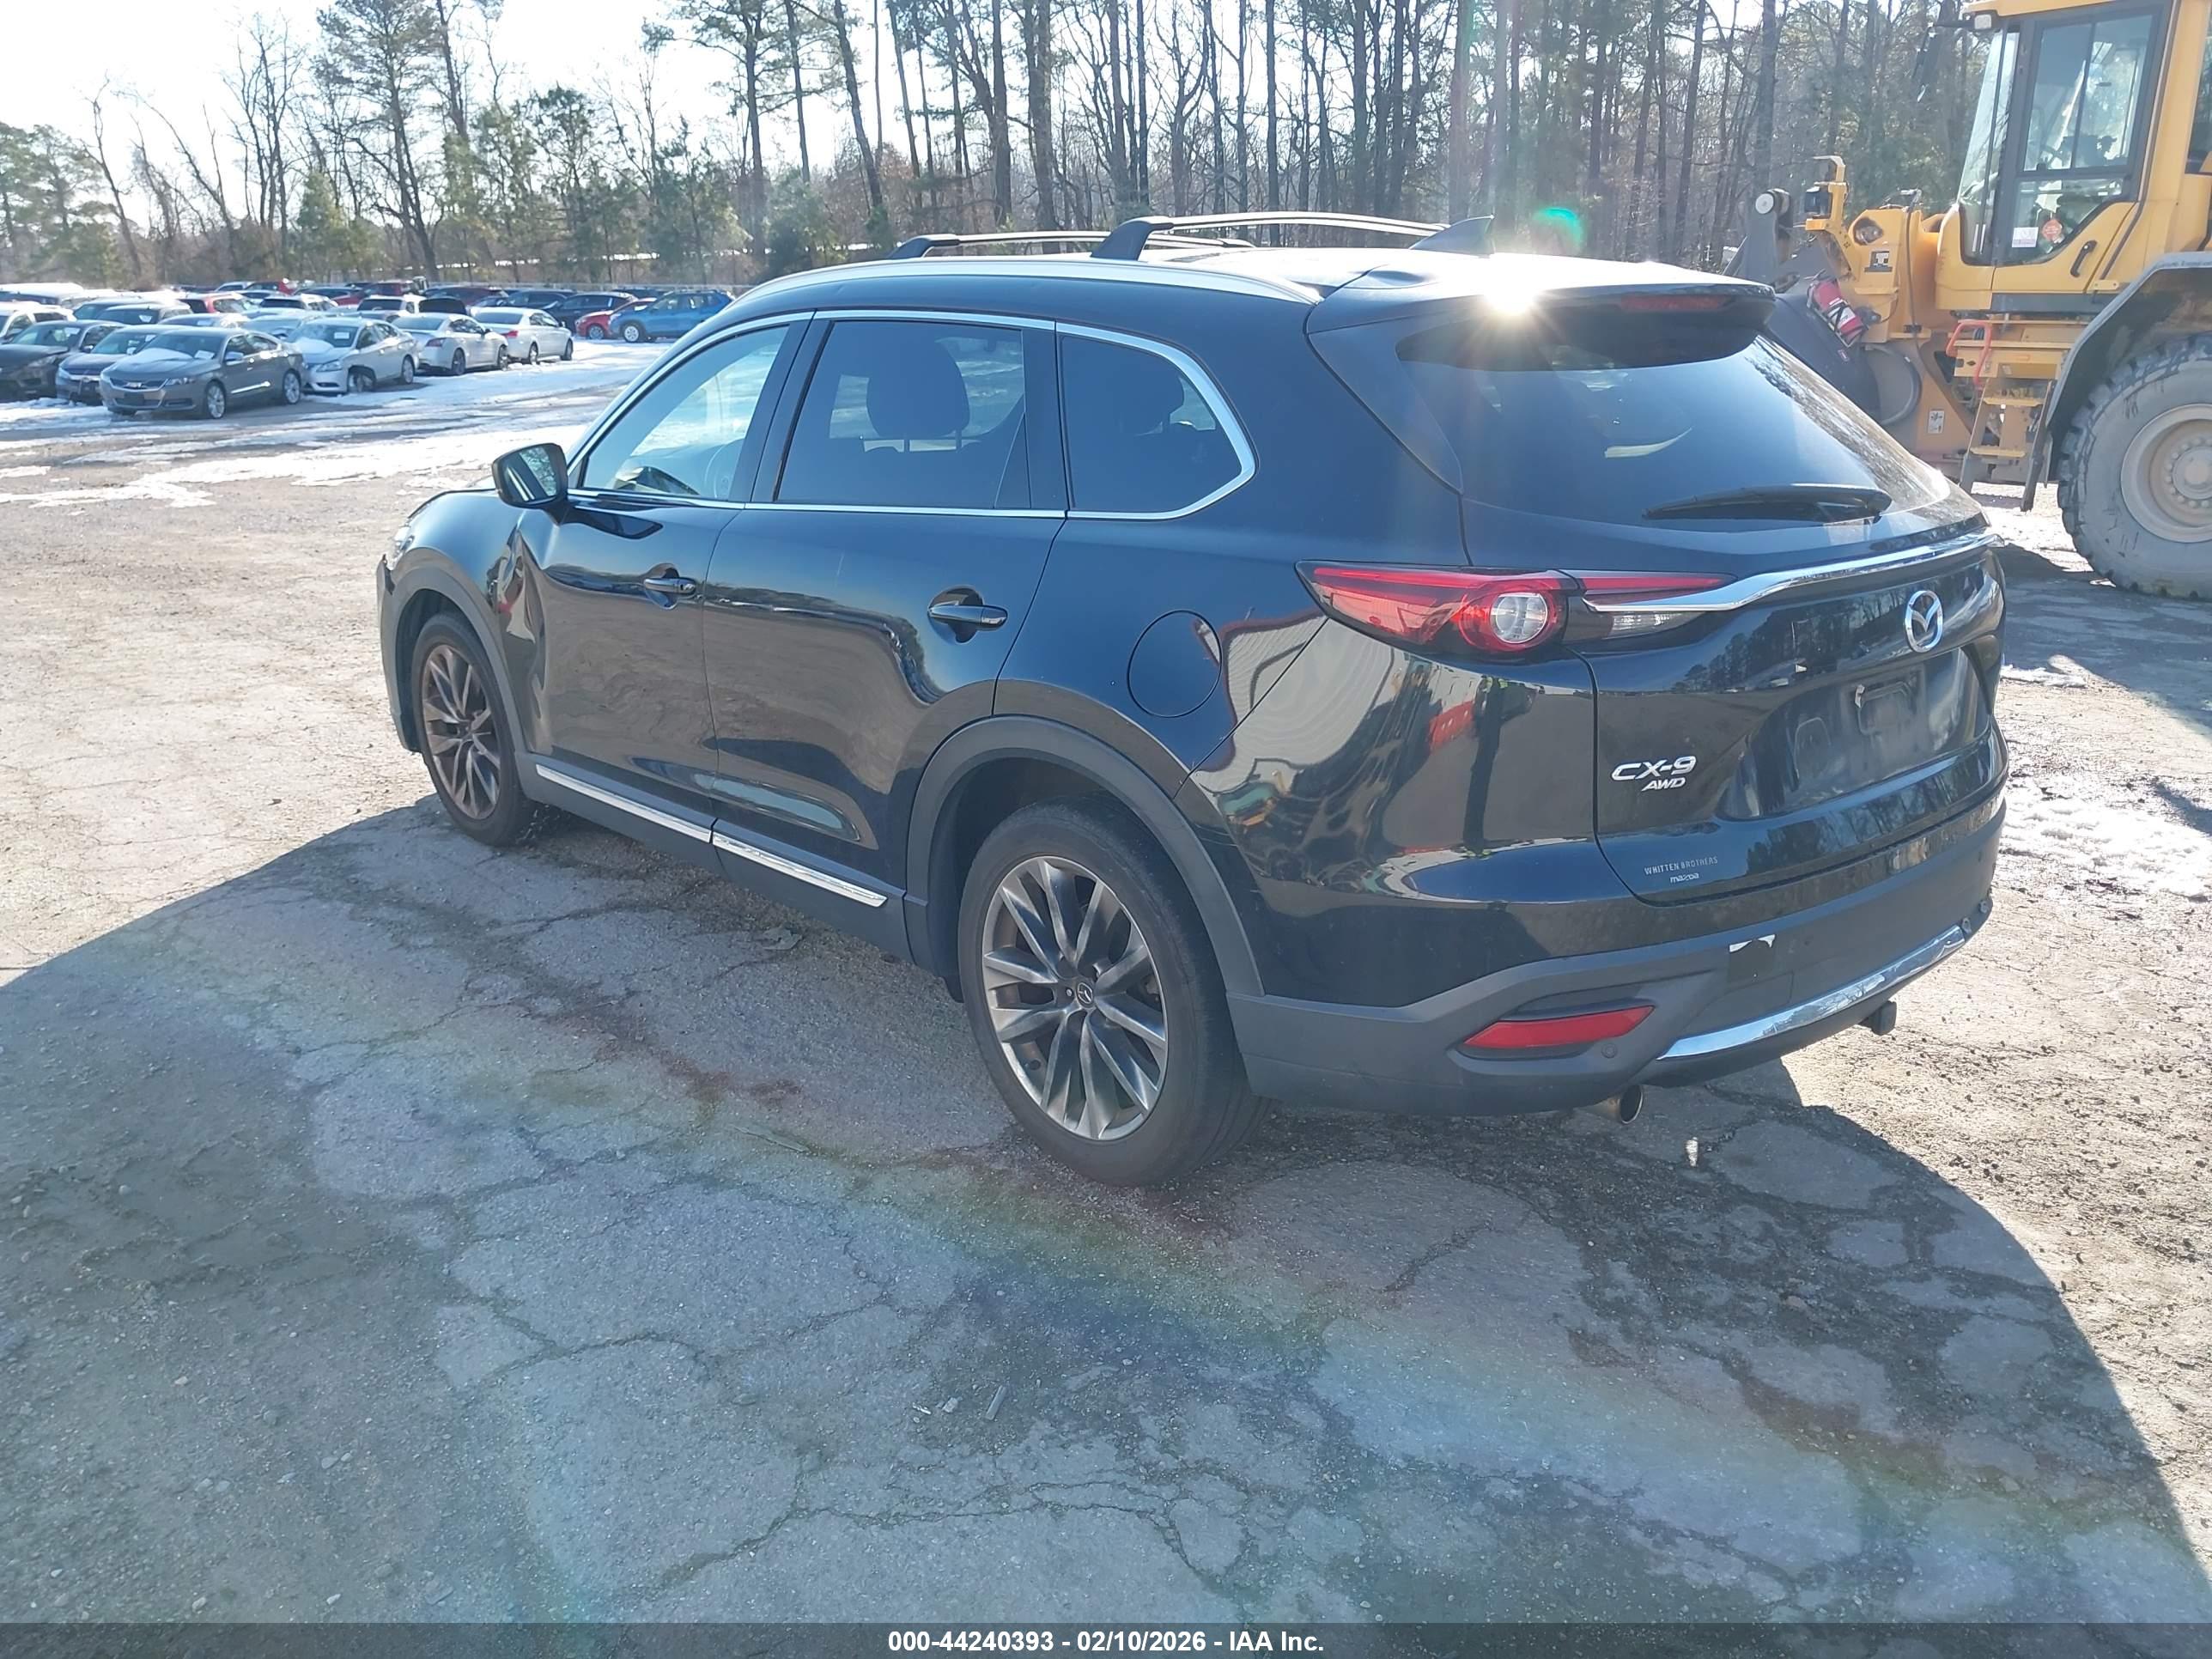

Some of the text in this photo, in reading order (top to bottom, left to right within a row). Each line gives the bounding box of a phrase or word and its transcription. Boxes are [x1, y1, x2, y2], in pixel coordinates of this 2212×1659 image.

[1611, 756, 1697, 781] CX-9
[1641, 777, 1686, 792] AWD
[1644, 856, 1718, 875] WHITTEN BROTHERS
